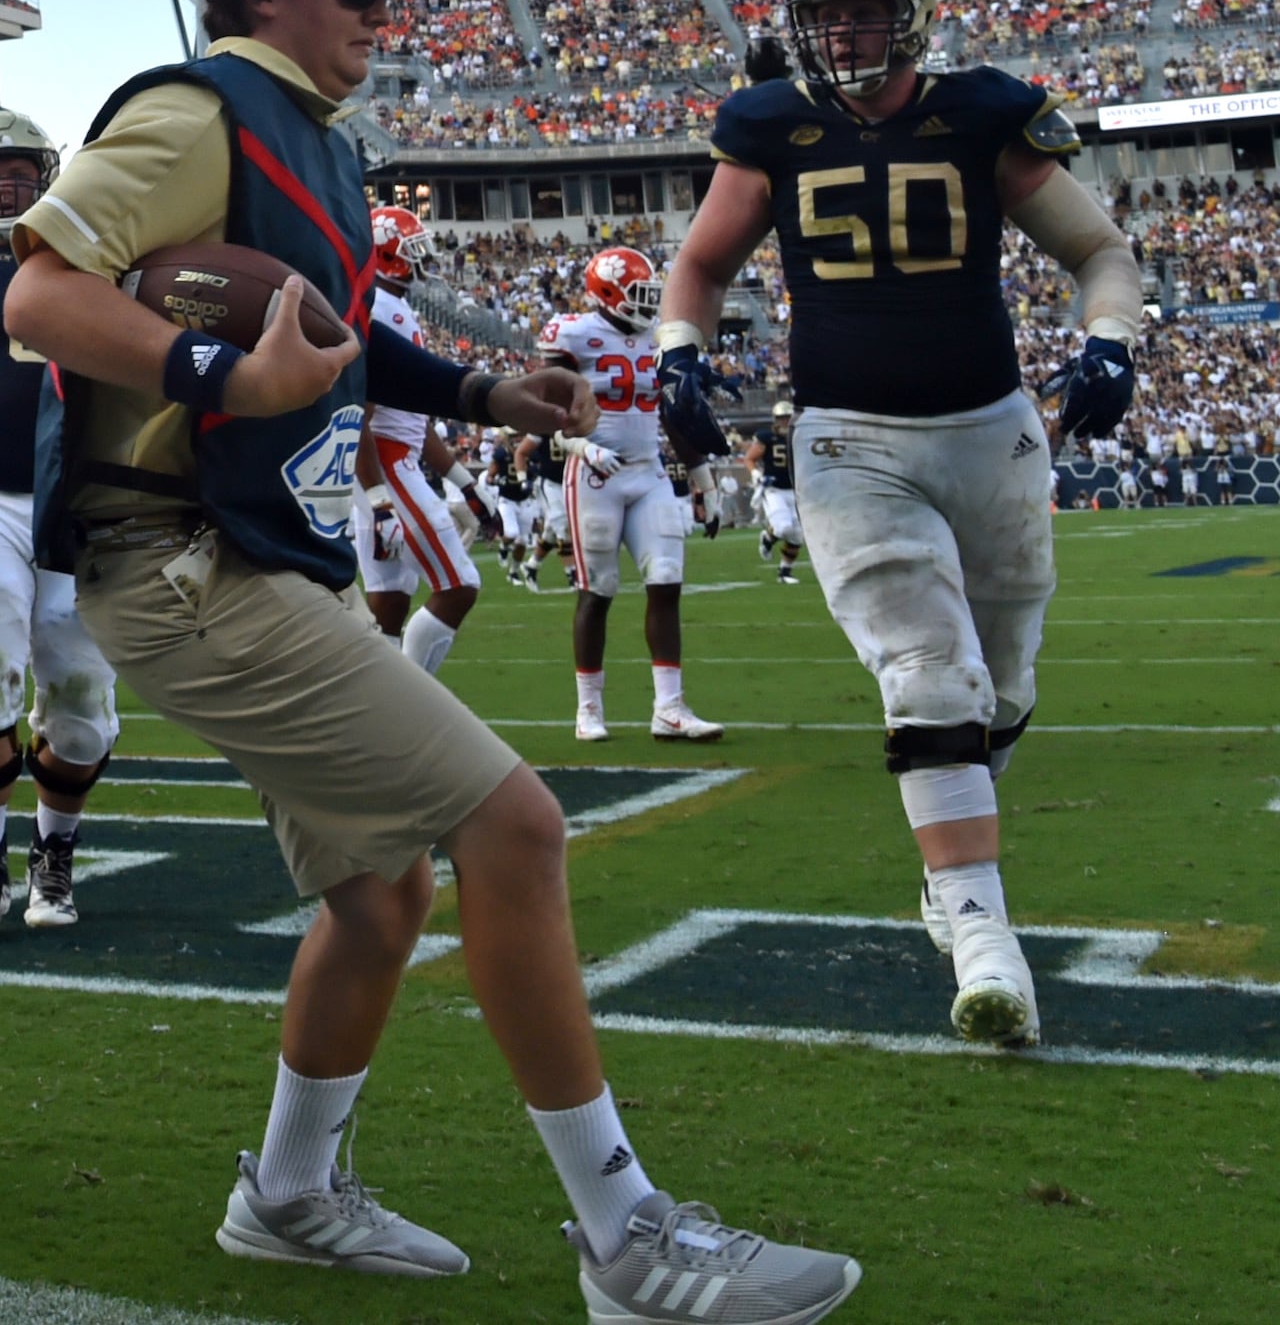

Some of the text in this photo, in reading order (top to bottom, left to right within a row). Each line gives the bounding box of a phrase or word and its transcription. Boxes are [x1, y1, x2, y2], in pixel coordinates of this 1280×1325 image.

[1188, 103, 1222, 117] THE
[1227, 97, 1280, 113] OFFIC
[798, 162, 968, 280] 50
[174, 270, 230, 288] DIME
[163, 294, 228, 318] adidas
[313, 442, 359, 486] AC
